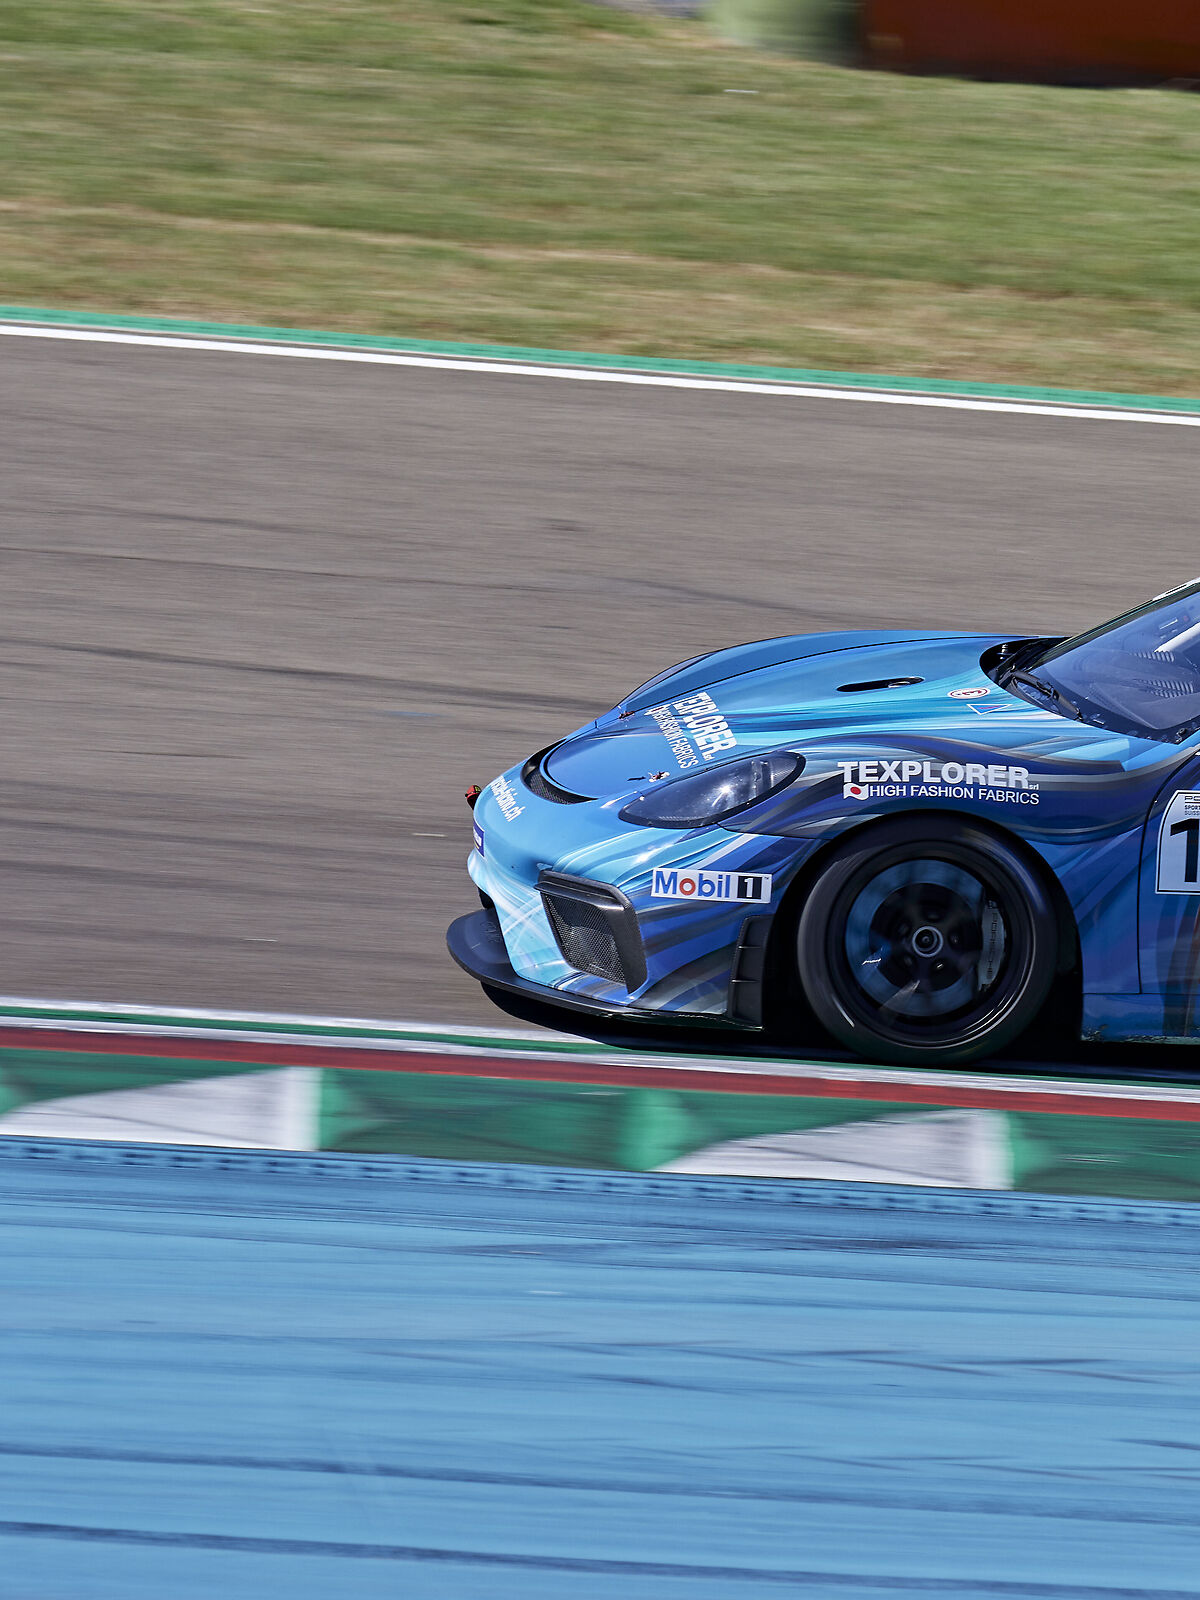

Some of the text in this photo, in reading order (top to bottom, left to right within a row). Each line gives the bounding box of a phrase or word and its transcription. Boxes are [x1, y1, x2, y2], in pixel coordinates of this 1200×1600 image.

[671, 691, 738, 752] TEXPLORER
[666, 736, 699, 769] FABRICS
[837, 760, 1040, 791] TEXPLORER srl
[869, 785, 1040, 805] HIGH FASHION FABRICS
[655, 871, 731, 898] Mobil
